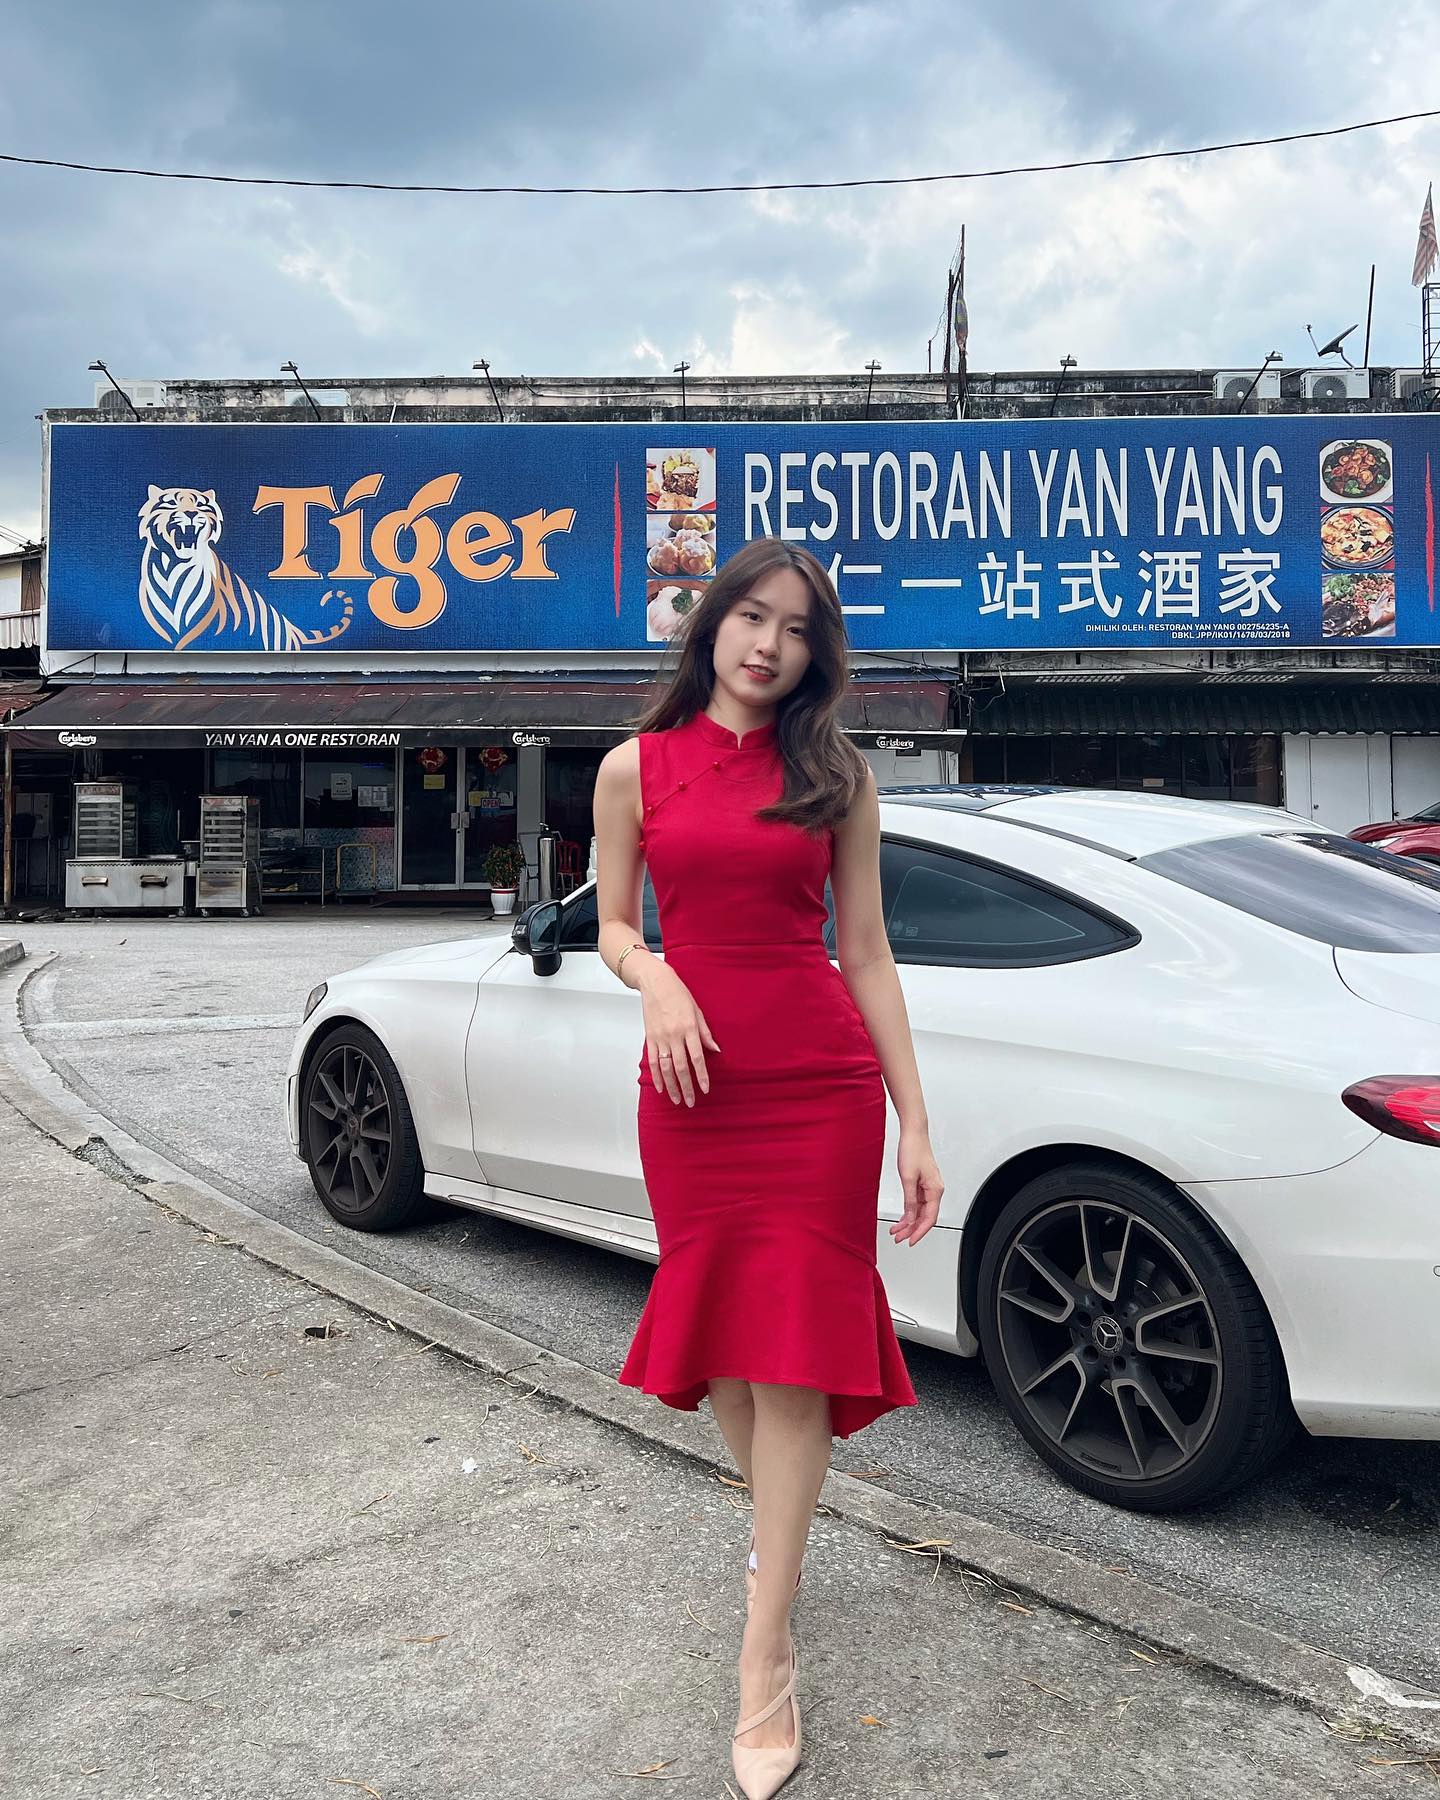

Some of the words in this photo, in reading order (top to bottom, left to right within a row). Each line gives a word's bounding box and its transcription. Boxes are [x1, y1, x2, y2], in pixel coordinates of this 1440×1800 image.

[744, 449, 1012, 541] RESTORAN
[1028, 447, 1128, 538] YAN
[1145, 445, 1284, 536] YANG
[252, 473, 577, 630] Tiger
[1085, 623, 1120, 632] DIMILIKI
[1121, 623, 1147, 632] OLEH:
[1148, 623, 1193, 631] RESTORAN
[1194, 623, 1211, 631] YAN
[1212, 623, 1236, 631] YANG
[1236, 622, 1290, 631] 002754235-A
[1171, 631, 1195, 639] DBKL
[58, 731, 97, 747] Carlsberg
[205, 733, 235, 746] YAN
[239, 733, 268, 746] YAN
[270, 733, 281, 746] A
[284, 733, 318, 746] ONE
[320, 733, 401, 746] RESTORAN
[512, 732, 551, 747] Carlsberg
[876, 735, 915, 749] Carlsberg
